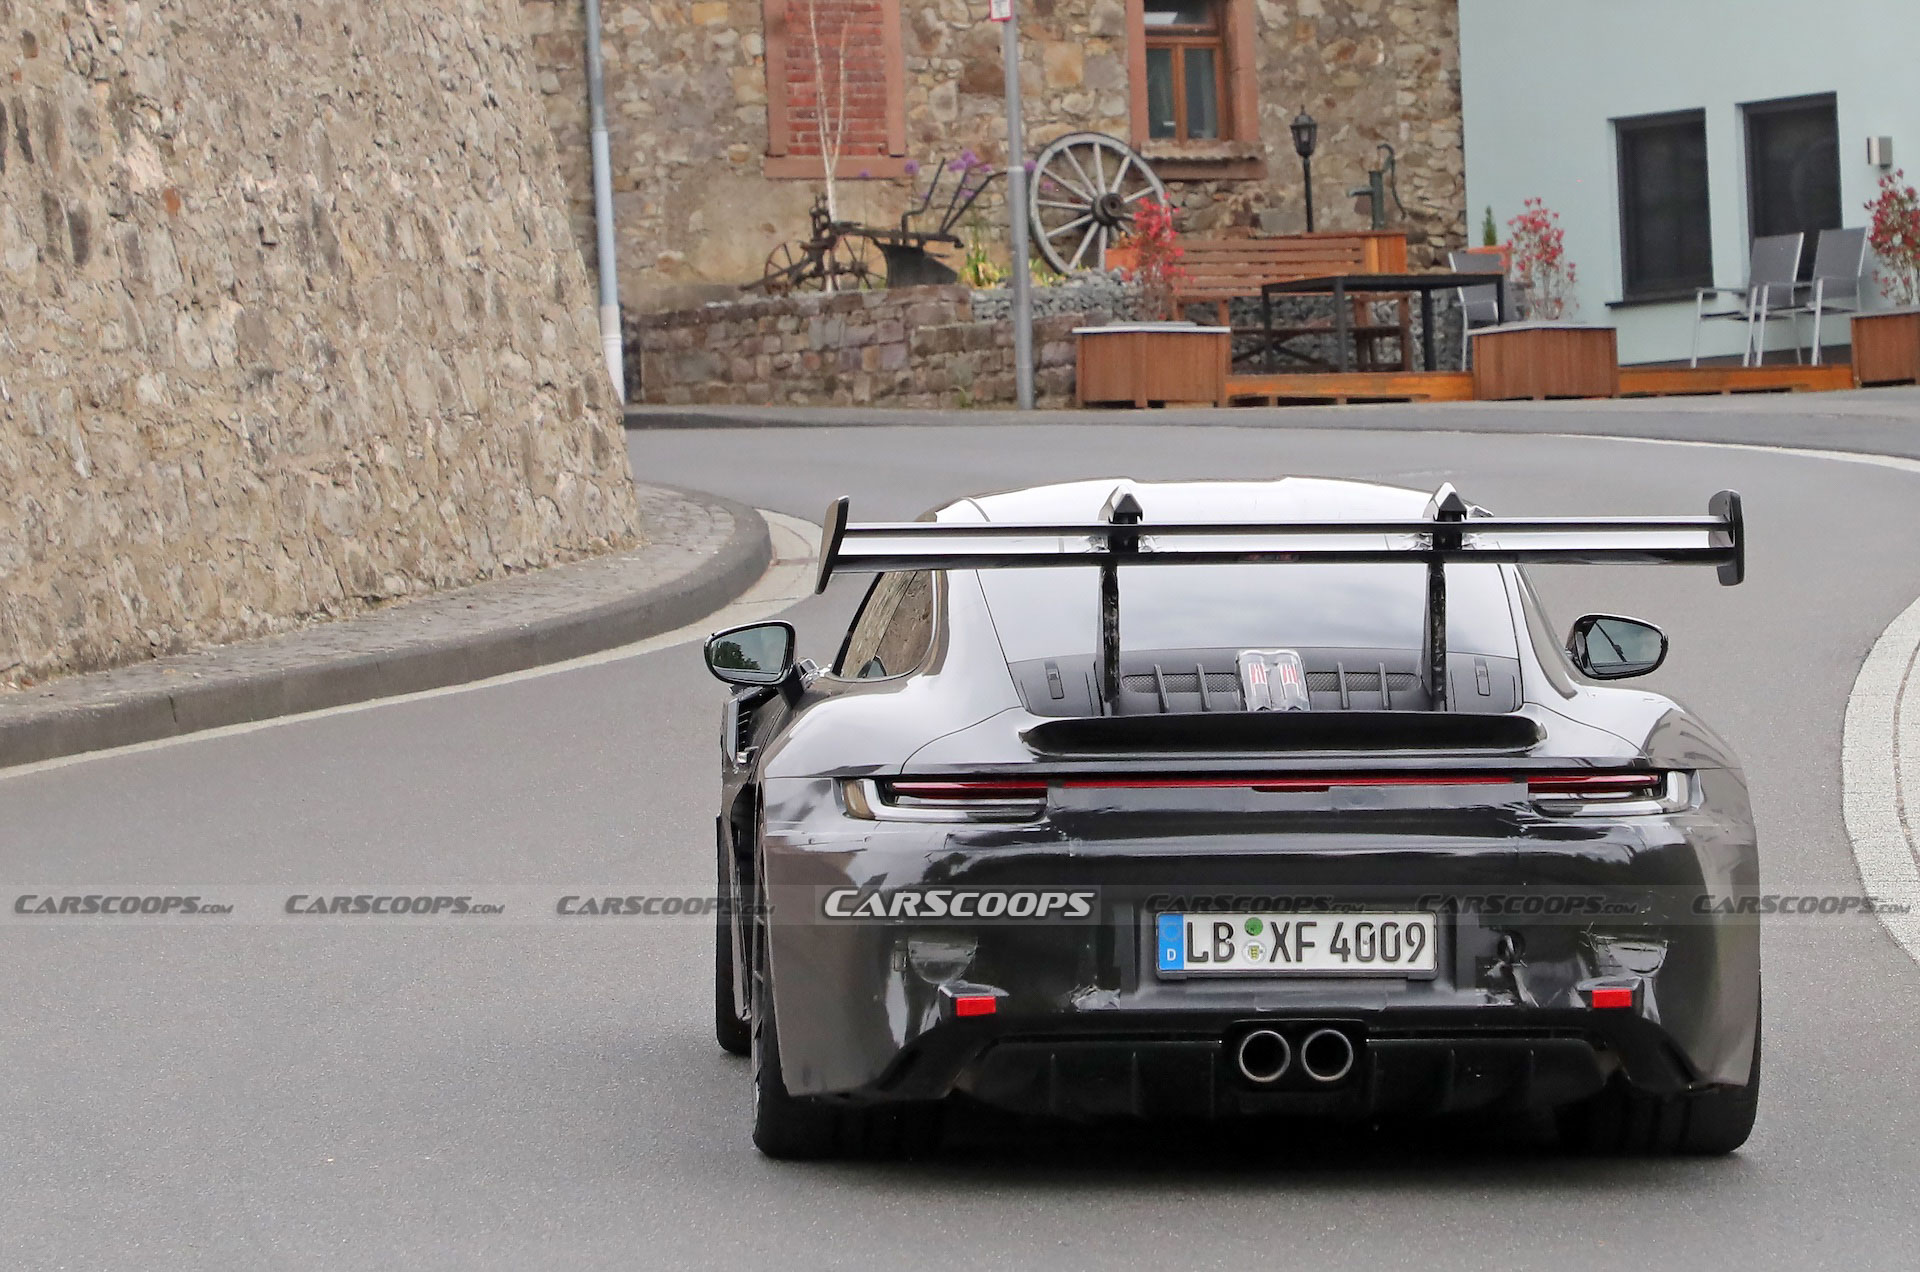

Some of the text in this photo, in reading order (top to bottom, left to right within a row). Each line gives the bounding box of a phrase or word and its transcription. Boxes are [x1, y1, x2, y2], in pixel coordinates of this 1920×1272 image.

[1166, 949, 1177, 961] D
[1186, 921, 1426, 963] LB XF 4009
